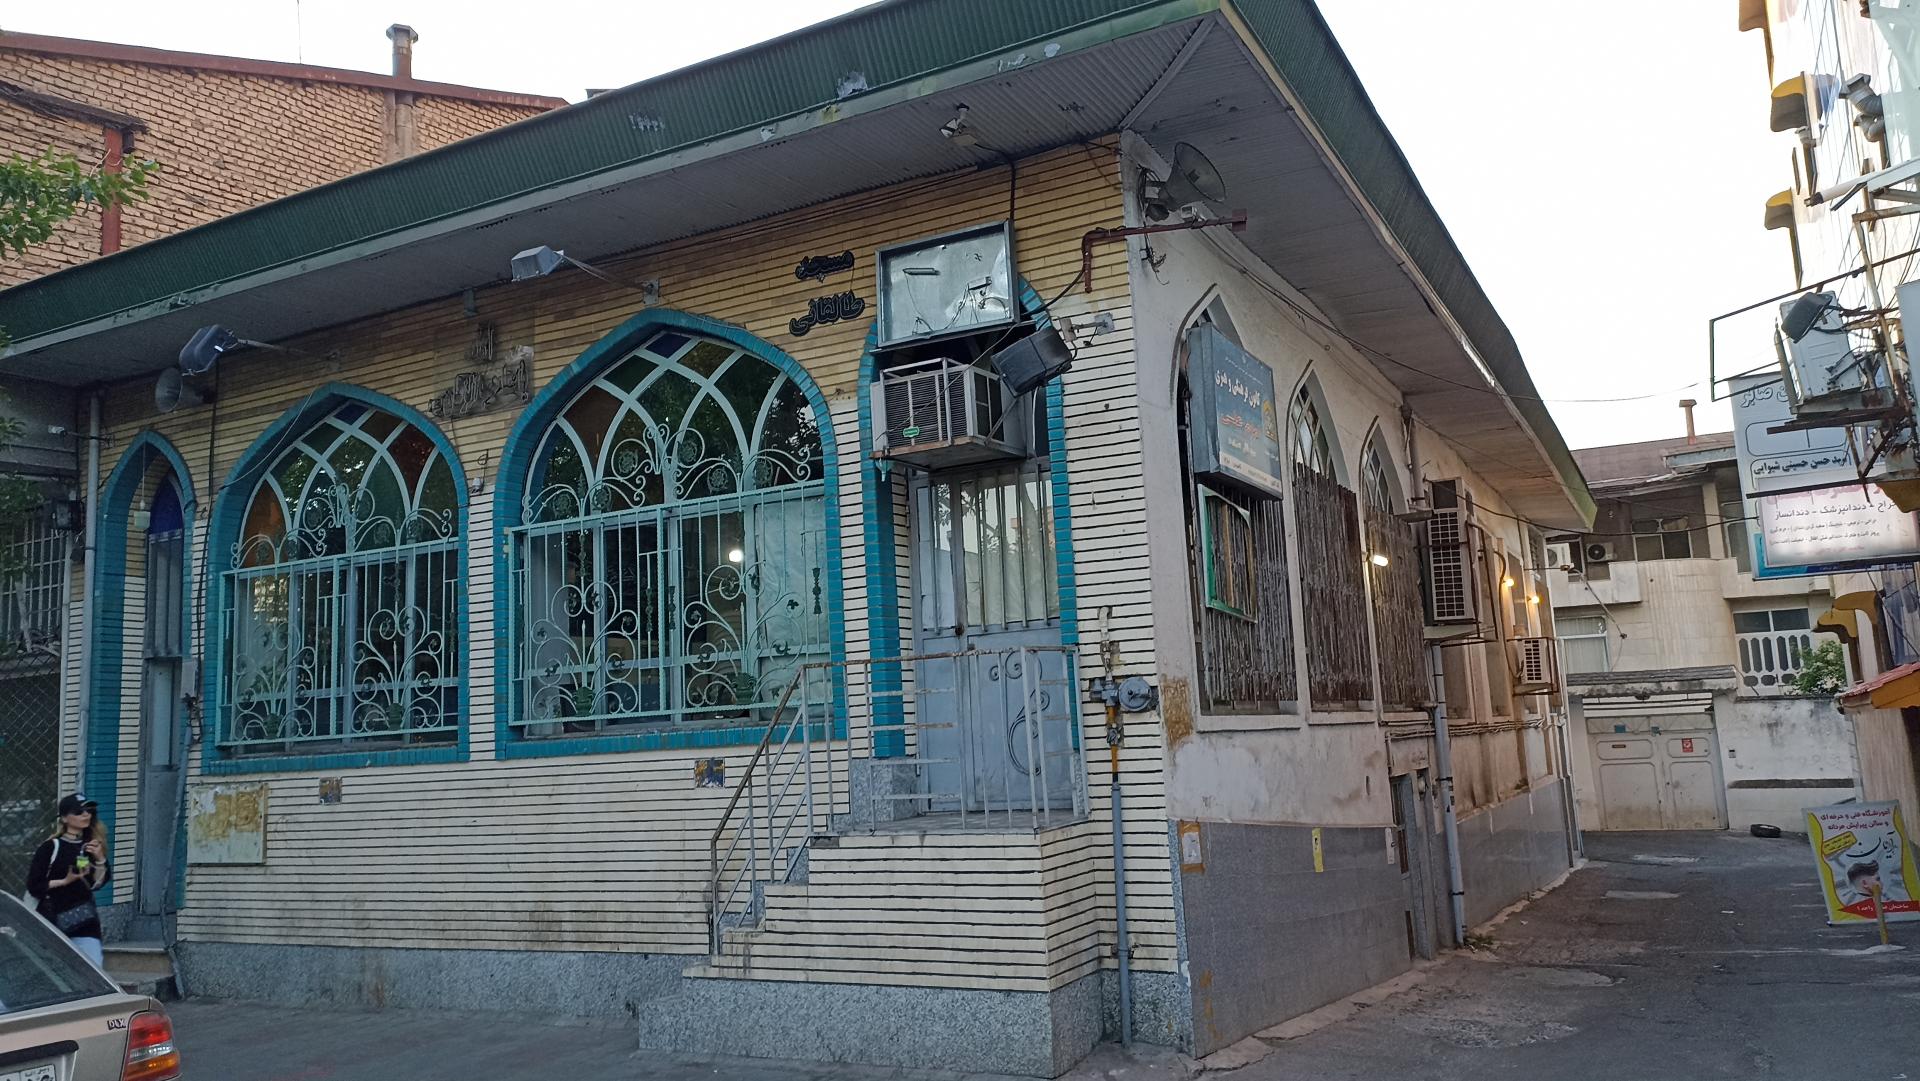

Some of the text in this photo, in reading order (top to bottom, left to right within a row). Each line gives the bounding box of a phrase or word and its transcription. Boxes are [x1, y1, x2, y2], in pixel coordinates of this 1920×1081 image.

[789, 289, 865, 337] طالقانی
[1248, 390, 1261, 409] کانون
[1782, 459, 1808, 472] حسینی
[1810, 457, 1830, 470] حسن
[1775, 509, 1810, 521] دندانساز
[1819, 503, 1867, 515] دندانپزشک
[1850, 811, 1861, 819] فنی
[107, 1018, 126, 1031] DLX
